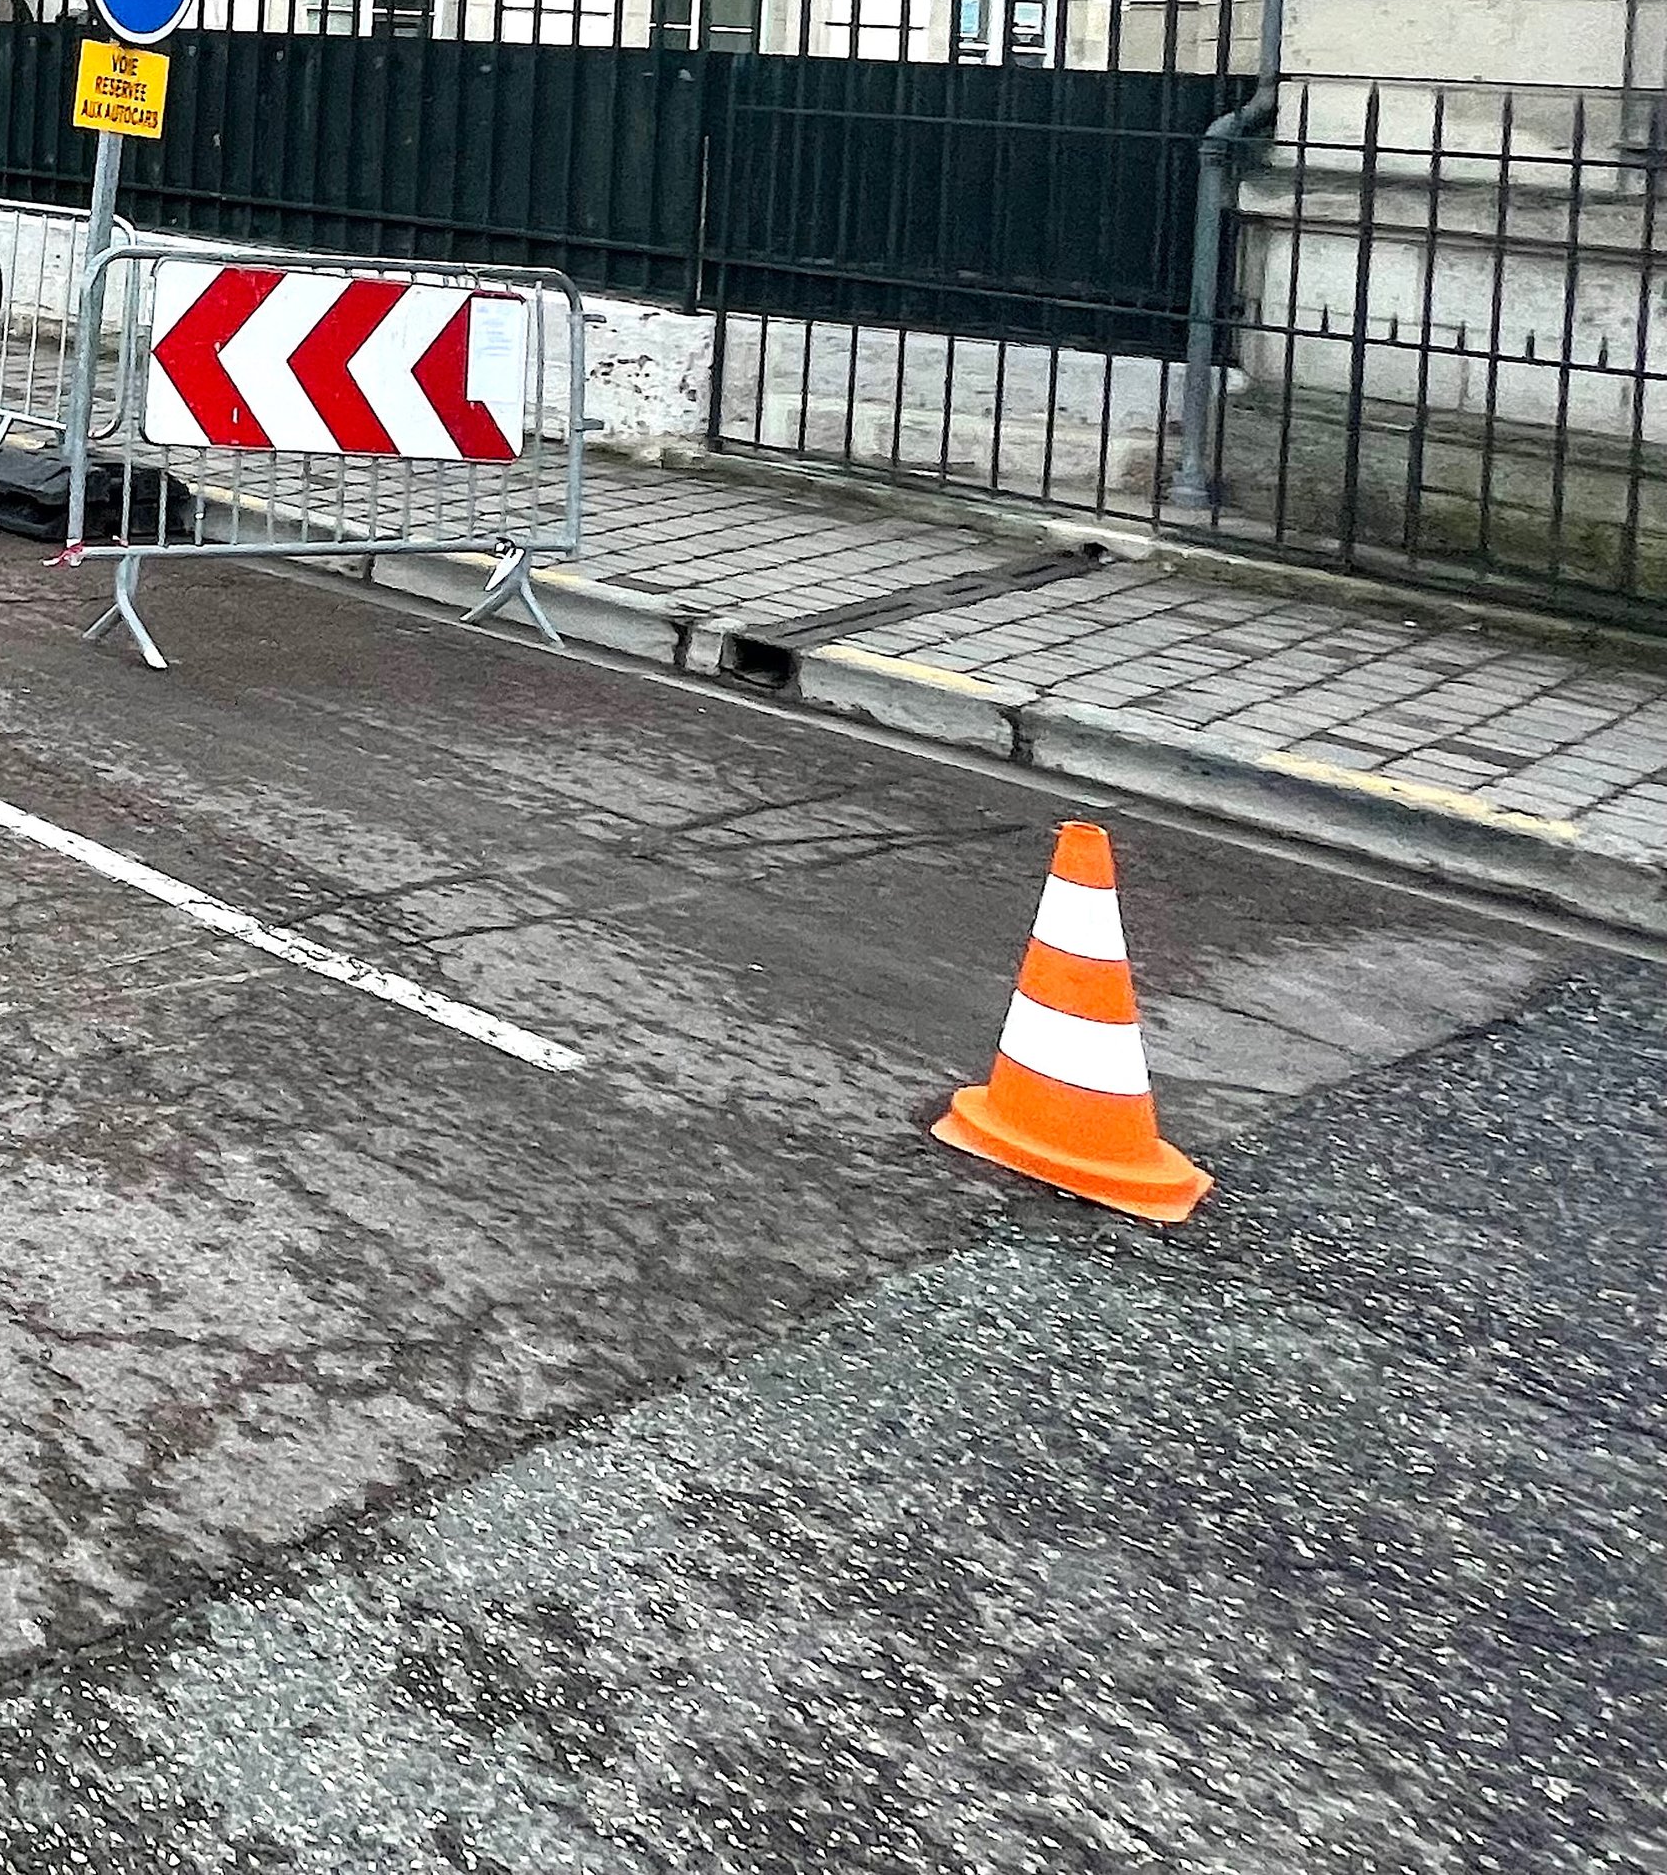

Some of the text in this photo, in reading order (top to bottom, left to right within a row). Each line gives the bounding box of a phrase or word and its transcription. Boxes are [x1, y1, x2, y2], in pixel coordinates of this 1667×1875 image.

[111, 54, 139, 76] VOIE
[81, 99, 159, 129] AUX AUTOCARS
